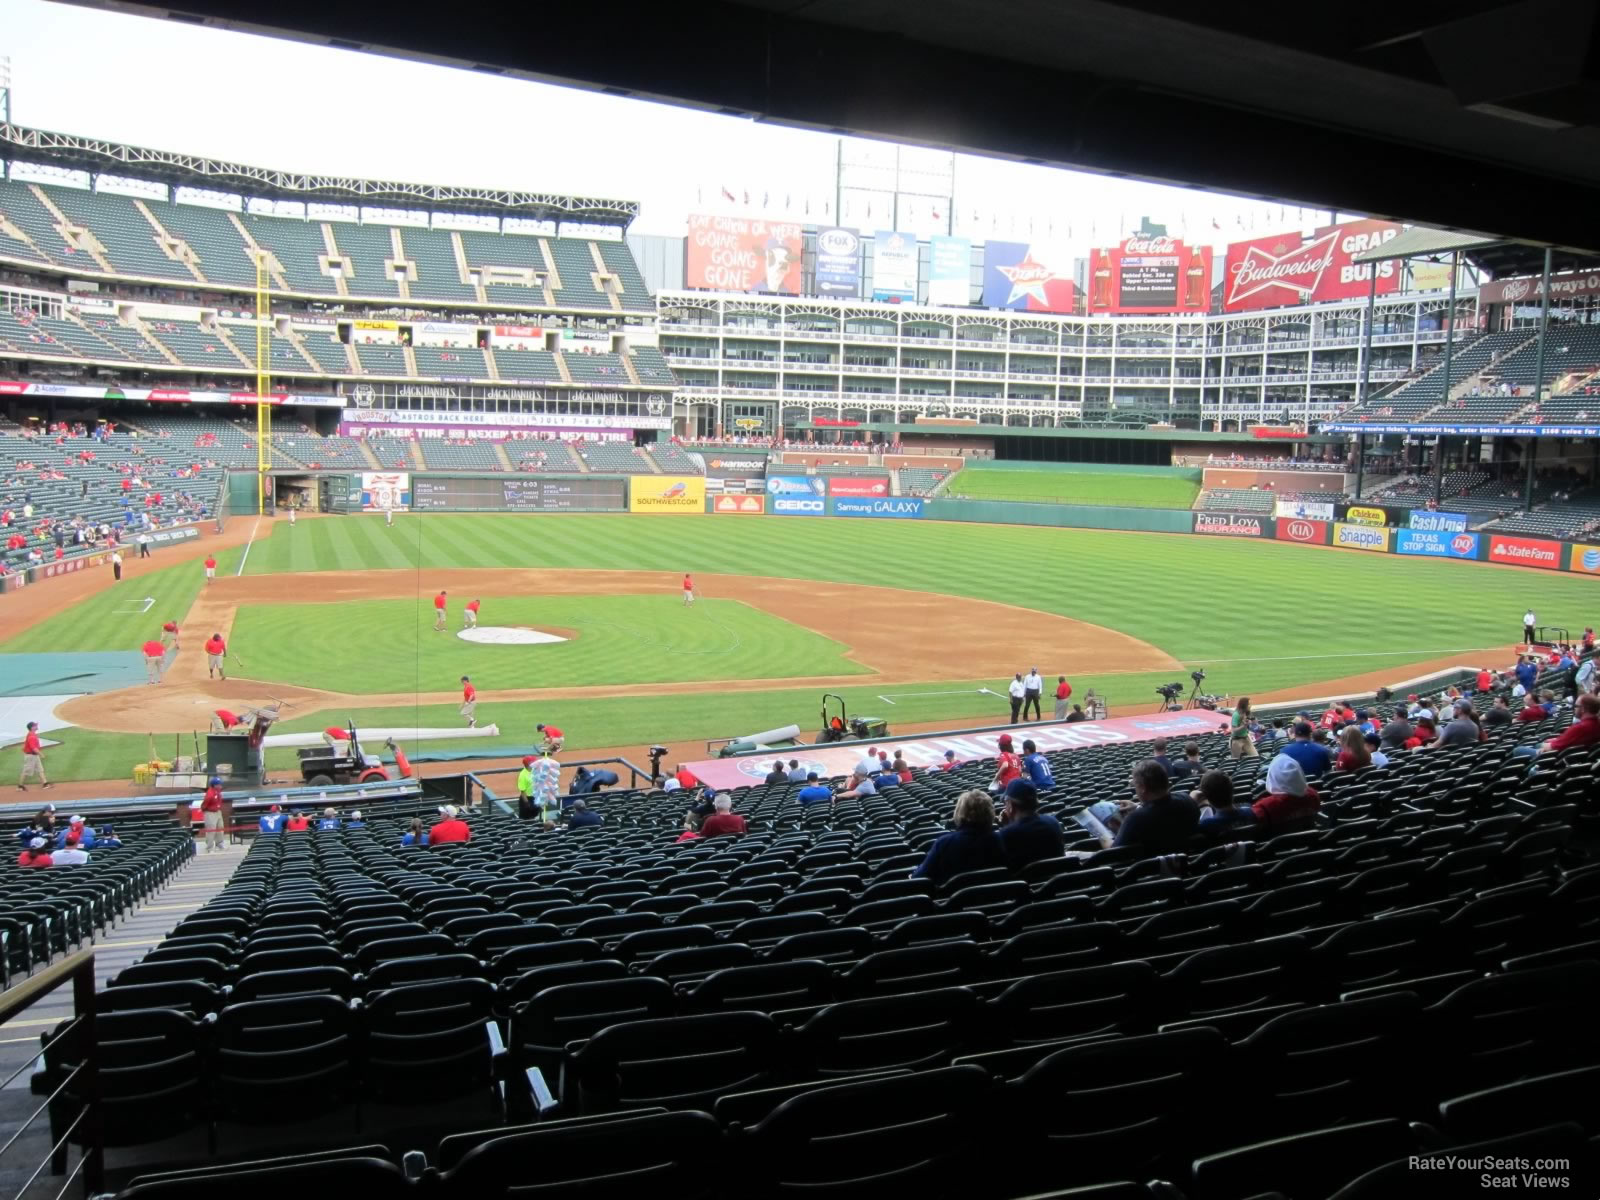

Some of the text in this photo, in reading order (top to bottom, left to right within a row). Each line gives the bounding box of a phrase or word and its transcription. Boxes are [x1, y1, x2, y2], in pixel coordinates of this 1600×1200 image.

[828, 234, 848, 247] FOX
[711, 247, 758, 270] GOING
[1231, 254, 1334, 285] Budweiser
[704, 265, 752, 290] GONE
[1534, 280, 1586, 295] Aways
[400, 384, 422, 396] JACK
[487, 388, 508, 398] JACK
[571, 390, 592, 401] JACK
[358, 411, 389, 422] HOUSTON
[401, 413, 434, 421] ASTROS
[601, 433, 627, 441] TIRE
[637, 498, 698, 506] SOUTHWEST.COM
[775, 500, 825, 511] GEICO
[837, 501, 920, 513] Samsung GALAXY
[1352, 509, 1380, 519] Chicken
[1197, 514, 1260, 528] FRED LOYA
[1195, 524, 1261, 536] INSURANCE
[1291, 524, 1310, 537] KIA
[1339, 527, 1383, 547] Snapple
[1411, 533, 1438, 543] TEXAS
[1403, 541, 1450, 553] STOP SIGN
[1456, 539, 1471, 550] DQ
[1040, 762, 1052, 776] 11
